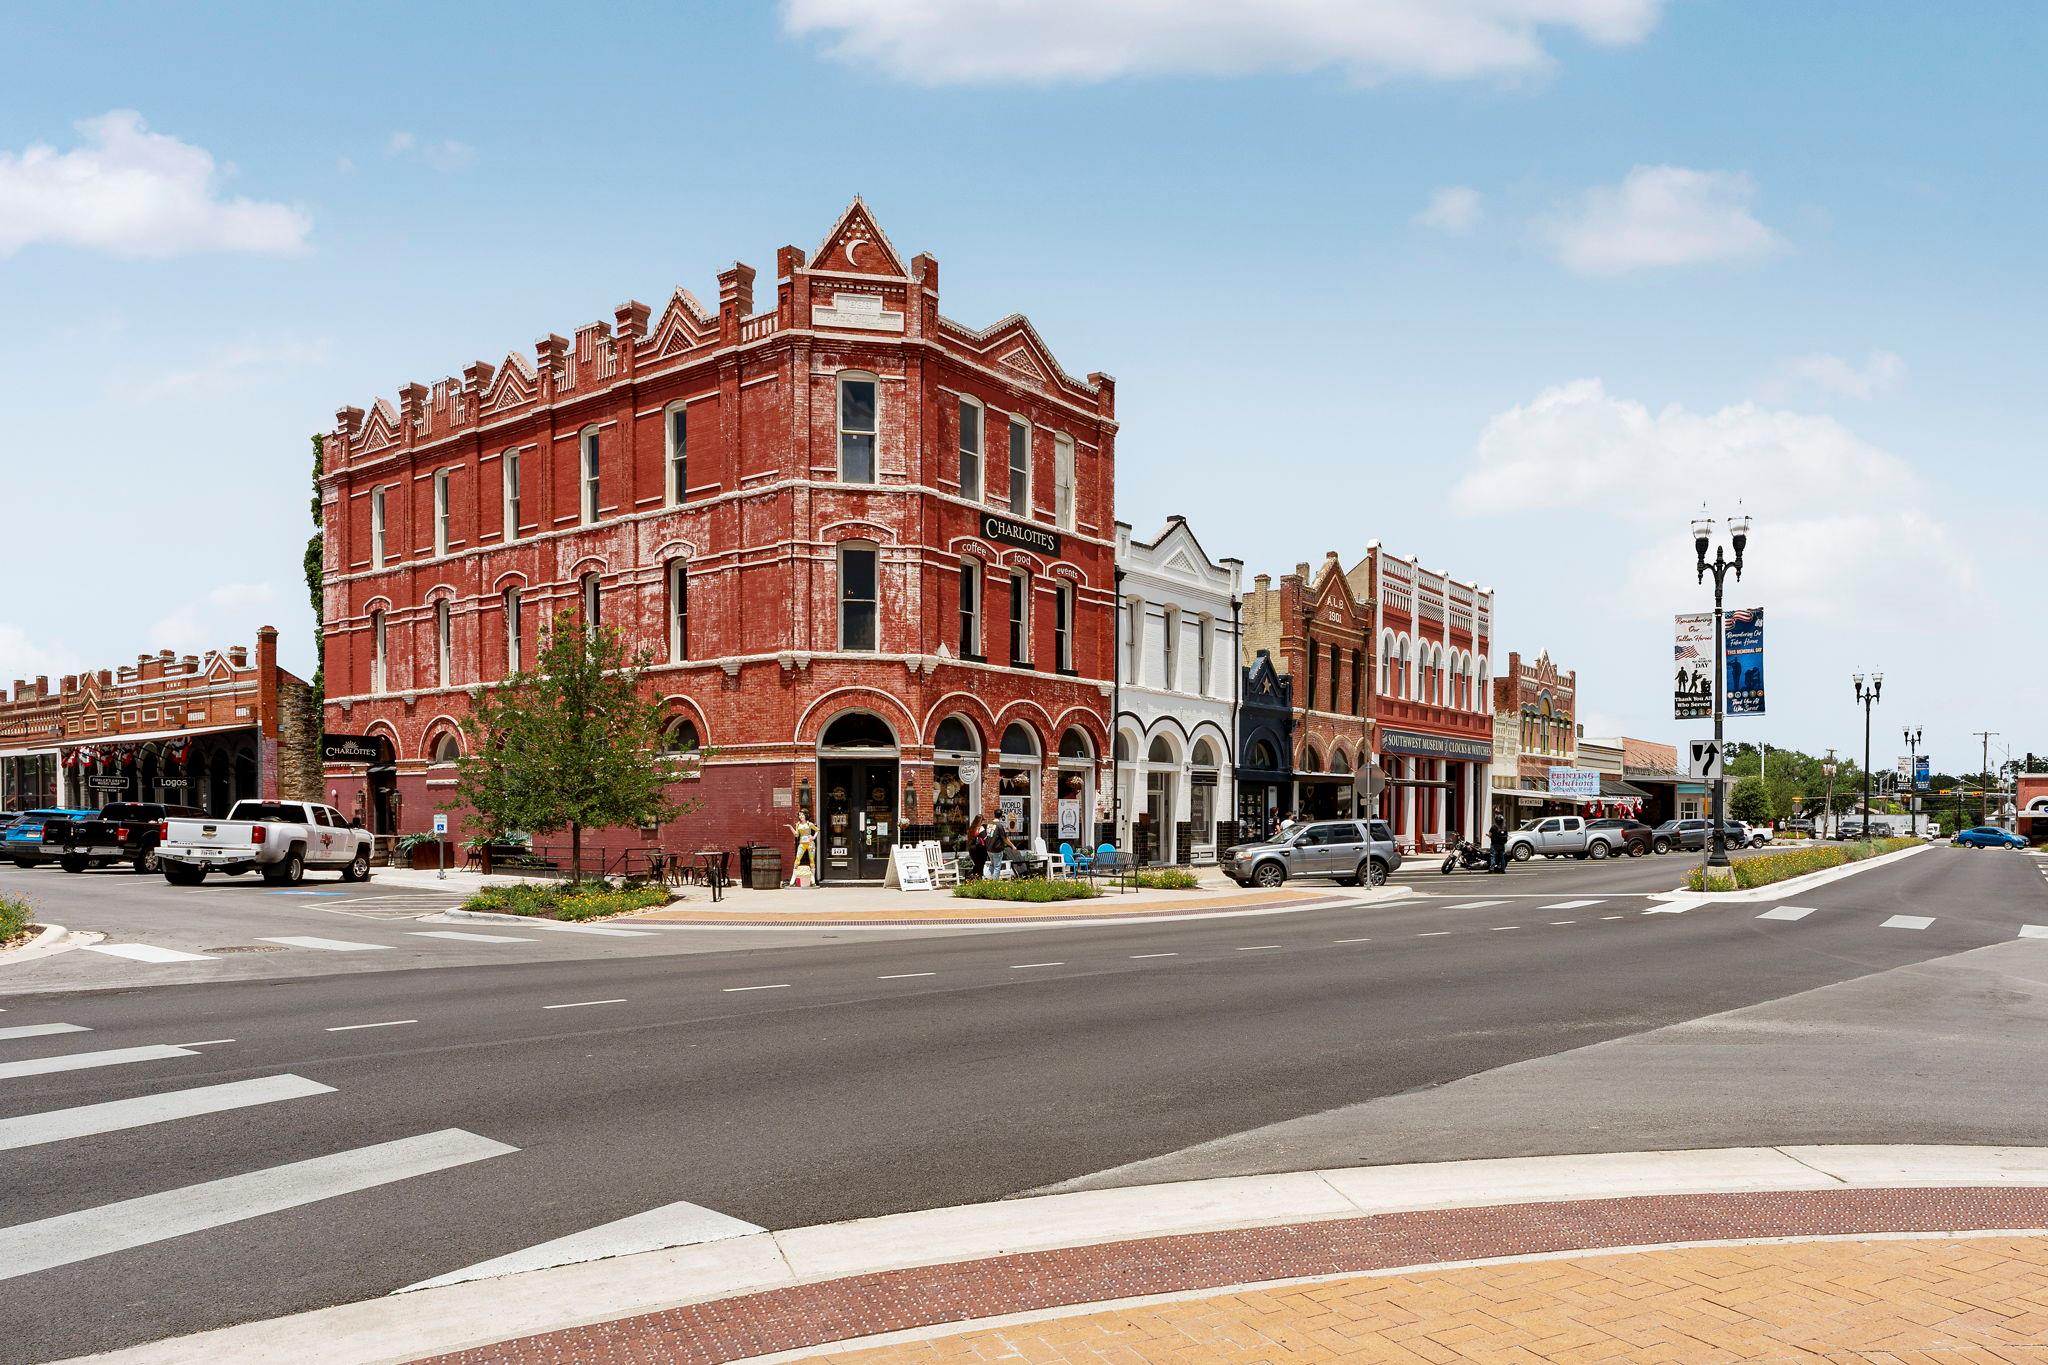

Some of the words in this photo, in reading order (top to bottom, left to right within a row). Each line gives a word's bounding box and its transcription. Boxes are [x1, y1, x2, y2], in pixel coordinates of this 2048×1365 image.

[962, 541, 987, 557] coffee
[1014, 552, 1031, 566] food
[1056, 567, 1078, 579] events
[1328, 611, 1342, 624] 1901
[1388, 734, 1421, 749] SOUTHWEST
[1422, 738, 1444, 752] MUSEUM
[1449, 742, 1467, 754] CLOCKS
[1471, 744, 1492, 757] WATCHES
[1551, 772, 1594, 780] PRINTING
[160, 778, 188, 787] Logos
[1001, 801, 1021, 809] WORLD
